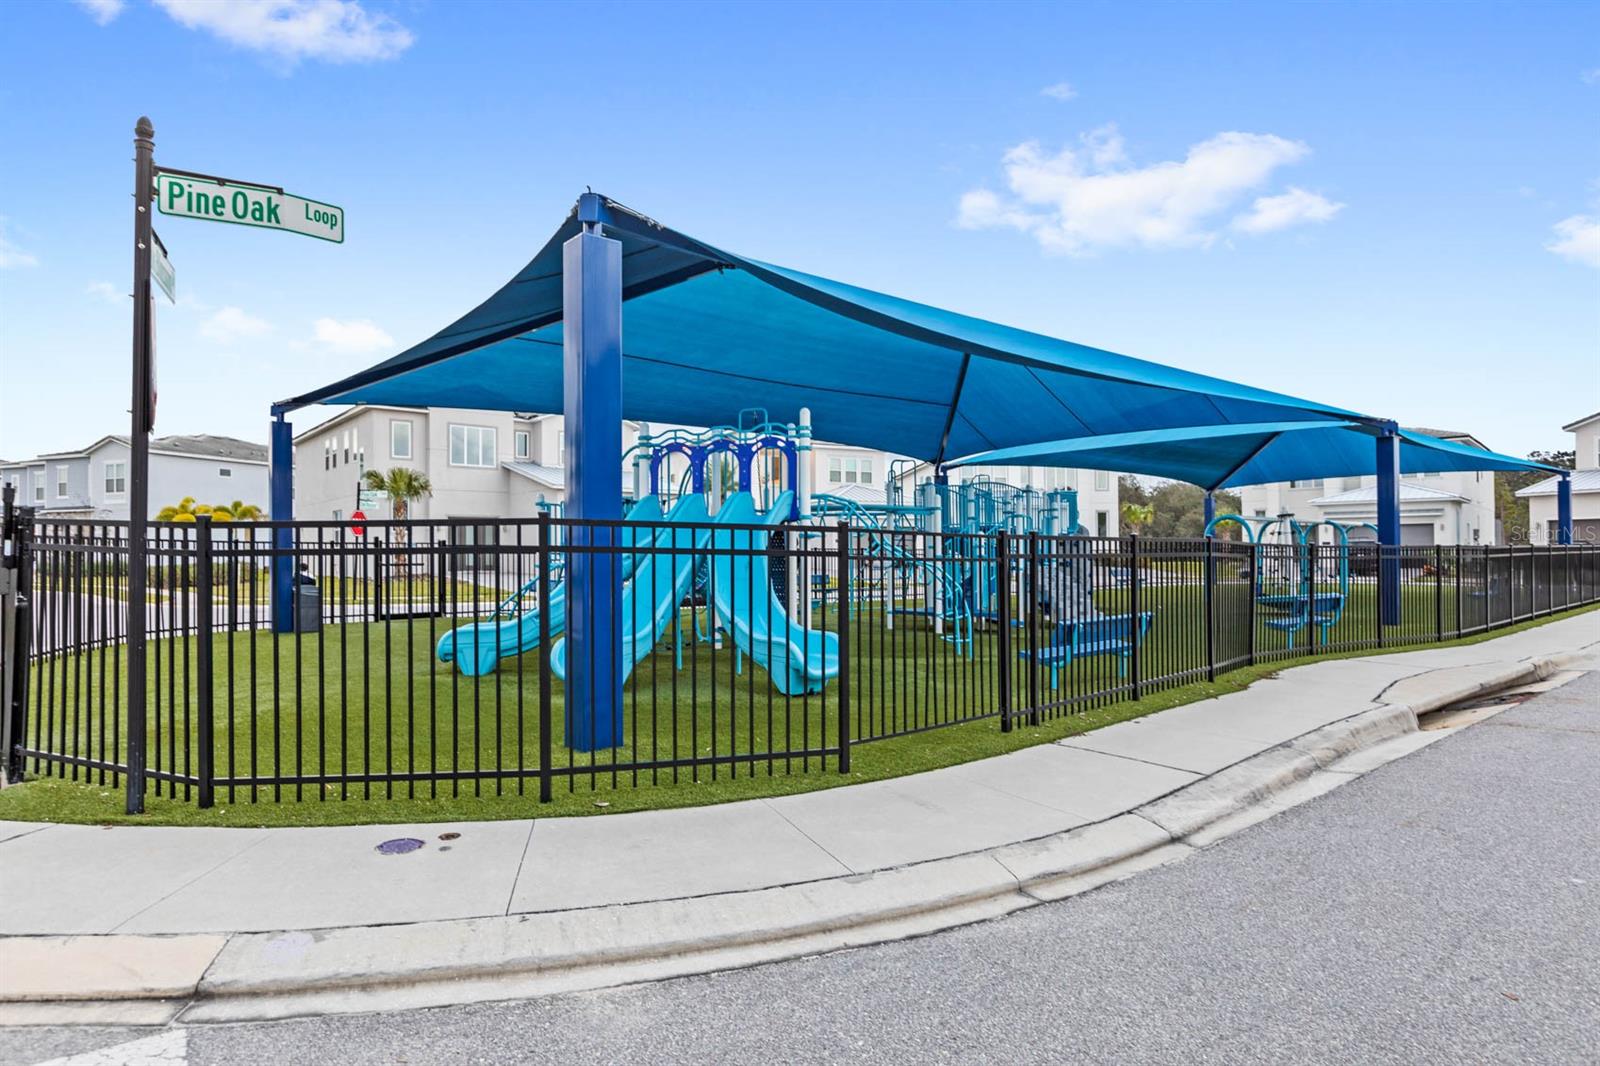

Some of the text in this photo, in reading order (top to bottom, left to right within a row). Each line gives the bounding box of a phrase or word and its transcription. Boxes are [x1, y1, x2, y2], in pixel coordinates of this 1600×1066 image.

[168, 181, 338, 230] Pine Oak Loop
